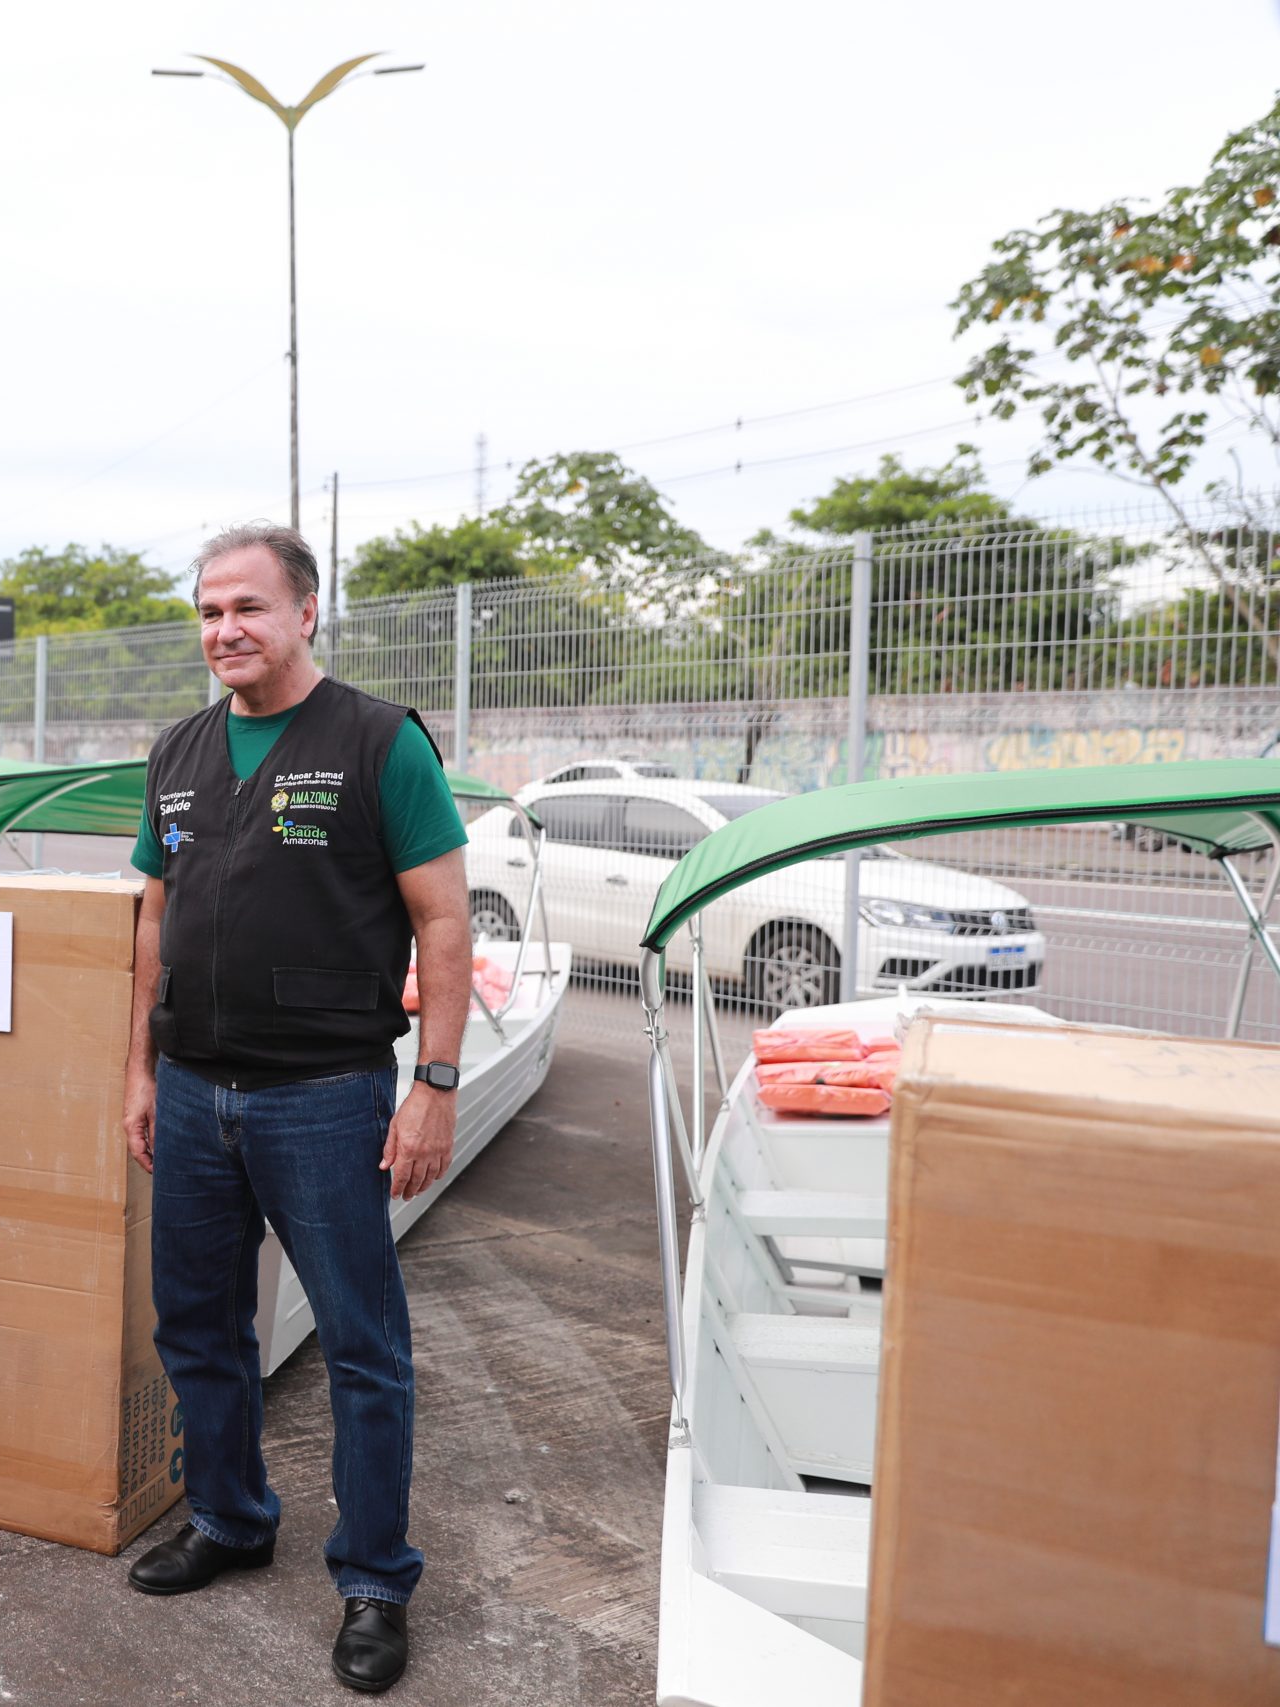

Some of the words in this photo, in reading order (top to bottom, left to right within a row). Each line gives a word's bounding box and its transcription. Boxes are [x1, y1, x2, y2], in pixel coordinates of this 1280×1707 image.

[275, 775, 287, 783] Dr.
[287, 773, 313, 781] Anoar
[314, 771, 344, 780] Samad
[160, 792, 187, 802] Secretaria
[187, 789, 195, 797] de
[290, 792, 338, 806] AMAZONAS
[160, 798, 192, 816] Saúde
[289, 827, 327, 838] Saúde
[283, 837, 328, 846] Amazonas
[149, 1378, 159, 1465] HD15FHS
[140, 1384, 150, 1485] HD15FHVS
